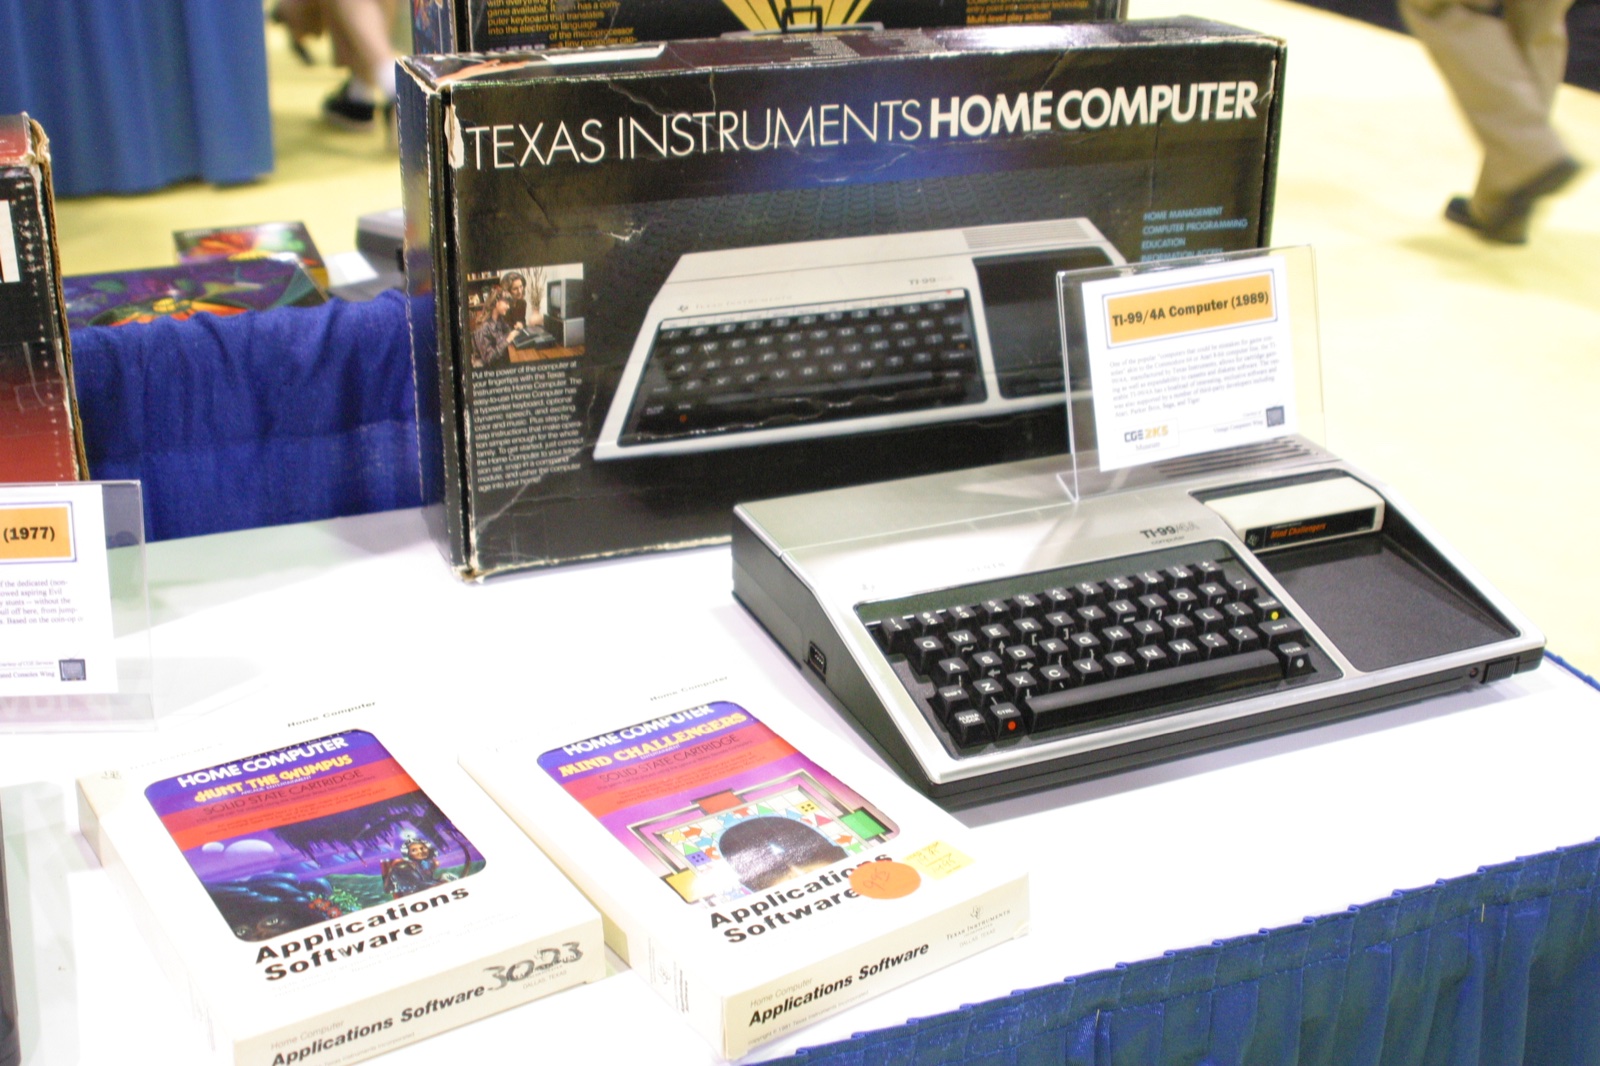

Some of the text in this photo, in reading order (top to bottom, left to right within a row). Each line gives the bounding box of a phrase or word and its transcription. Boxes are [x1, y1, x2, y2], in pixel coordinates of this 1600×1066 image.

[488, 20, 598, 35] into the electronic language
[510, 14, 548, 24] keyboard
[549, 27, 634, 40] of the microprocessor
[466, 118, 605, 171] TEXAS
[618, 98, 923, 160] INSTRUMENTS
[1142, 218, 1248, 236] COMPUTER PROGRAMMING
[1143, 206, 1224, 220] HOME MANAGEMENT
[1142, 238, 1186, 250] EDUCATION
[1112, 291, 1270, 327] TI-99/4A Computer (1989)
[472, 380, 487, 389] your
[488, 376, 519, 386] fingertips
[520, 374, 534, 382] with
[484, 370, 495, 378] the
[496, 368, 516, 378] power
[537, 362, 569, 372] computer
[512, 383, 533, 392] Home
[570, 376, 582, 384] The
[480, 404, 511, 414] typewriter
[546, 396, 572, 405] optional
[510, 392, 531, 400] Home
[532, 388, 564, 398] Computer
[1135, 440, 1161, 452] Museum
[3, 526, 56, 544] (1977)
[1270, 522, 1327, 540] Mind Challengers
[5, 580, 15, 588] the
[17, 578, 48, 587] dedicated
[20, 588, 62, 598] aspiring Evil
[954, 634, 968, 642] W
[1022, 622, 1034, 630] R
[1116, 604, 1128, 612] U
[1014, 650, 1026, 658] D
[1110, 630, 1124, 638] H
[1173, 618, 1186, 626] K
[982, 682, 994, 690] Z
[1015, 676, 1028, 684] X
[1112, 656, 1126, 664] B
[1144, 650, 1158, 658] N
[1175, 643, 1190, 652] M
[288, 702, 376, 728] Home Computer
[562, 704, 716, 756] HOME COMPUTER
[558, 755, 612, 778] MIND
[613, 712, 748, 761] CHALLENGERS
[599, 734, 738, 783] SOLID STATE CARTRIDGE
[177, 762, 242, 788] HOME
[242, 736, 349, 773] COMPUTER
[194, 782, 242, 803] HUNT
[245, 773, 280, 790] THE
[280, 754, 353, 781] WUMPUS
[203, 769, 364, 816] SOLID STATE CARTRIDGE
[266, 776, 312, 790] ENTERTAINMENT
[709, 854, 893, 929] Applicatios
[255, 887, 470, 964] Applications
[723, 886, 861, 944] Software
[264, 922, 423, 981] Software
[748, 942, 930, 1027] Applications Software
[750, 978, 812, 1008] Home Computer
[270, 1020, 344, 1051] Home Computer
[271, 986, 485, 1066] Applications Software
